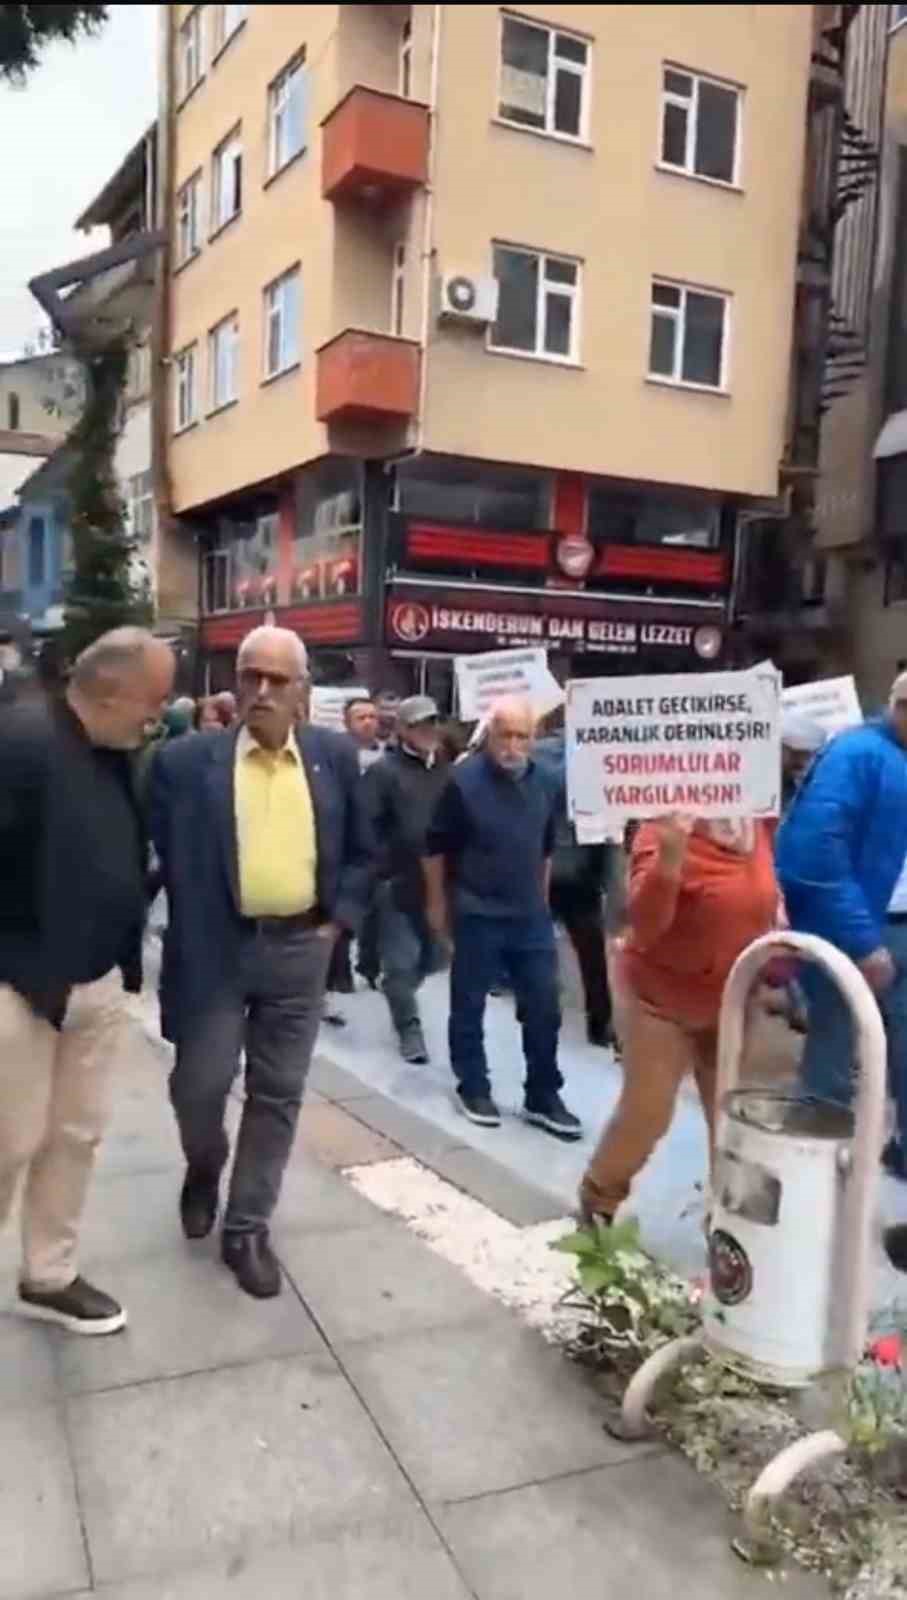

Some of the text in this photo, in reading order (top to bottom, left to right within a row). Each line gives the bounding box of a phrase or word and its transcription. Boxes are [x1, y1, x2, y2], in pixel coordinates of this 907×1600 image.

[587, 621, 637, 642] GELEN
[640, 624, 692, 645] LEZZET
[592, 698, 655, 716] ADALET
[576, 724, 660, 744] KARANLIK
[603, 750, 741, 774] SORUMLULAR
[603, 782, 742, 806] YARGILANSIN!
